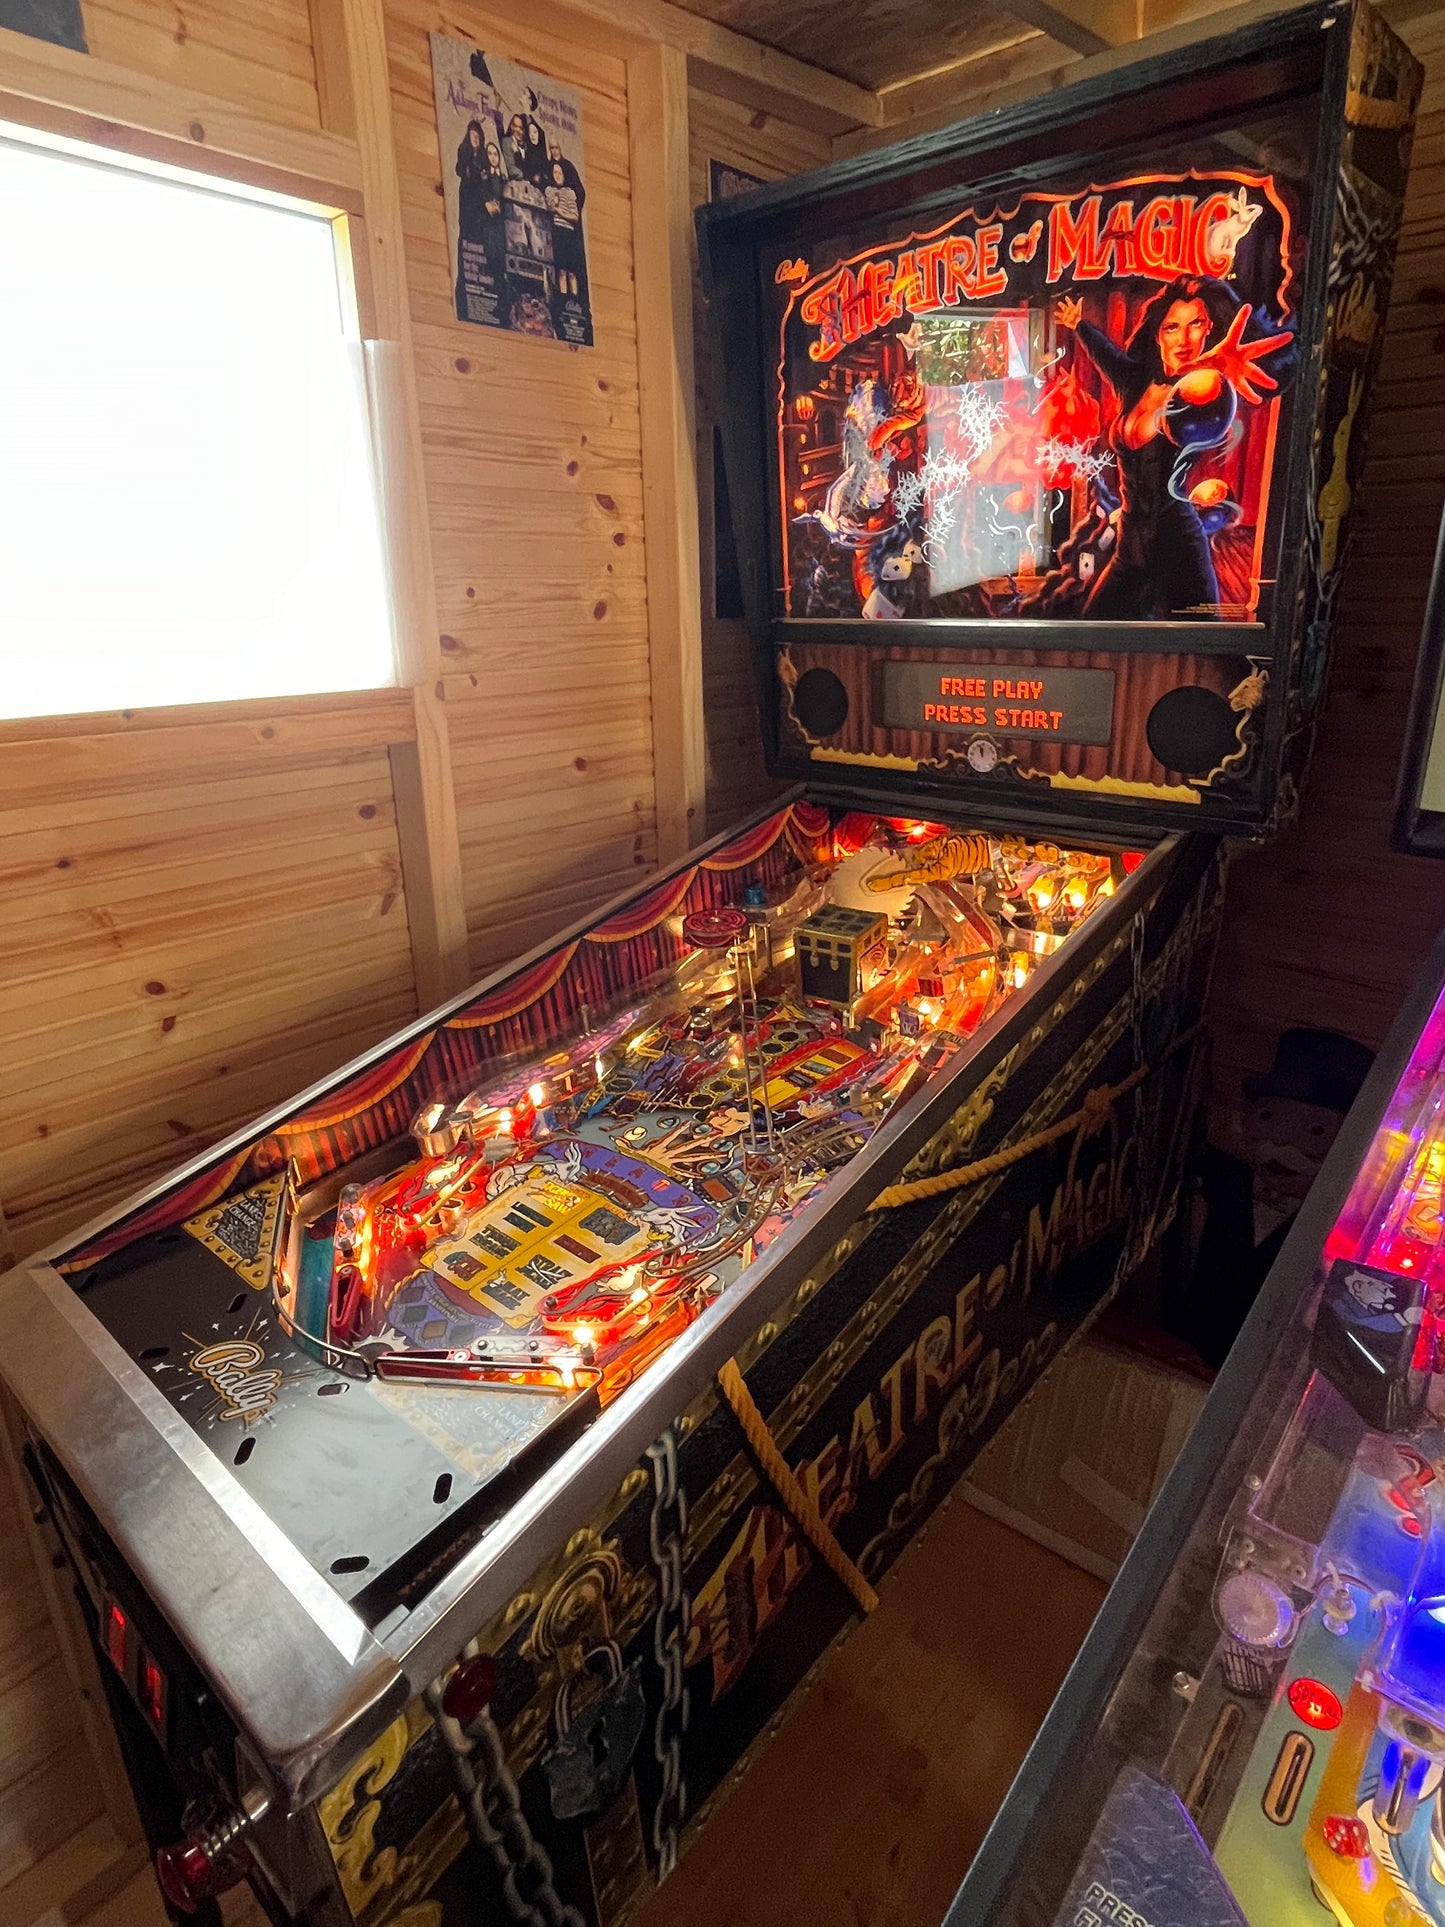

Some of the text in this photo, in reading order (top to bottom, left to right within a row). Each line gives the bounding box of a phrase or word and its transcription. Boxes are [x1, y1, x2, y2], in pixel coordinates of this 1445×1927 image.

[801, 194, 1234, 362] THEATRE of MAGIC
[940, 677, 1044, 700] FREE PLAY
[924, 704, 1063, 730] PRESS START
[229, 1206, 257, 1227] CHANGE
[192, 1342, 281, 1419] Bally
[1085, 1881, 1157, 1927] PRES
